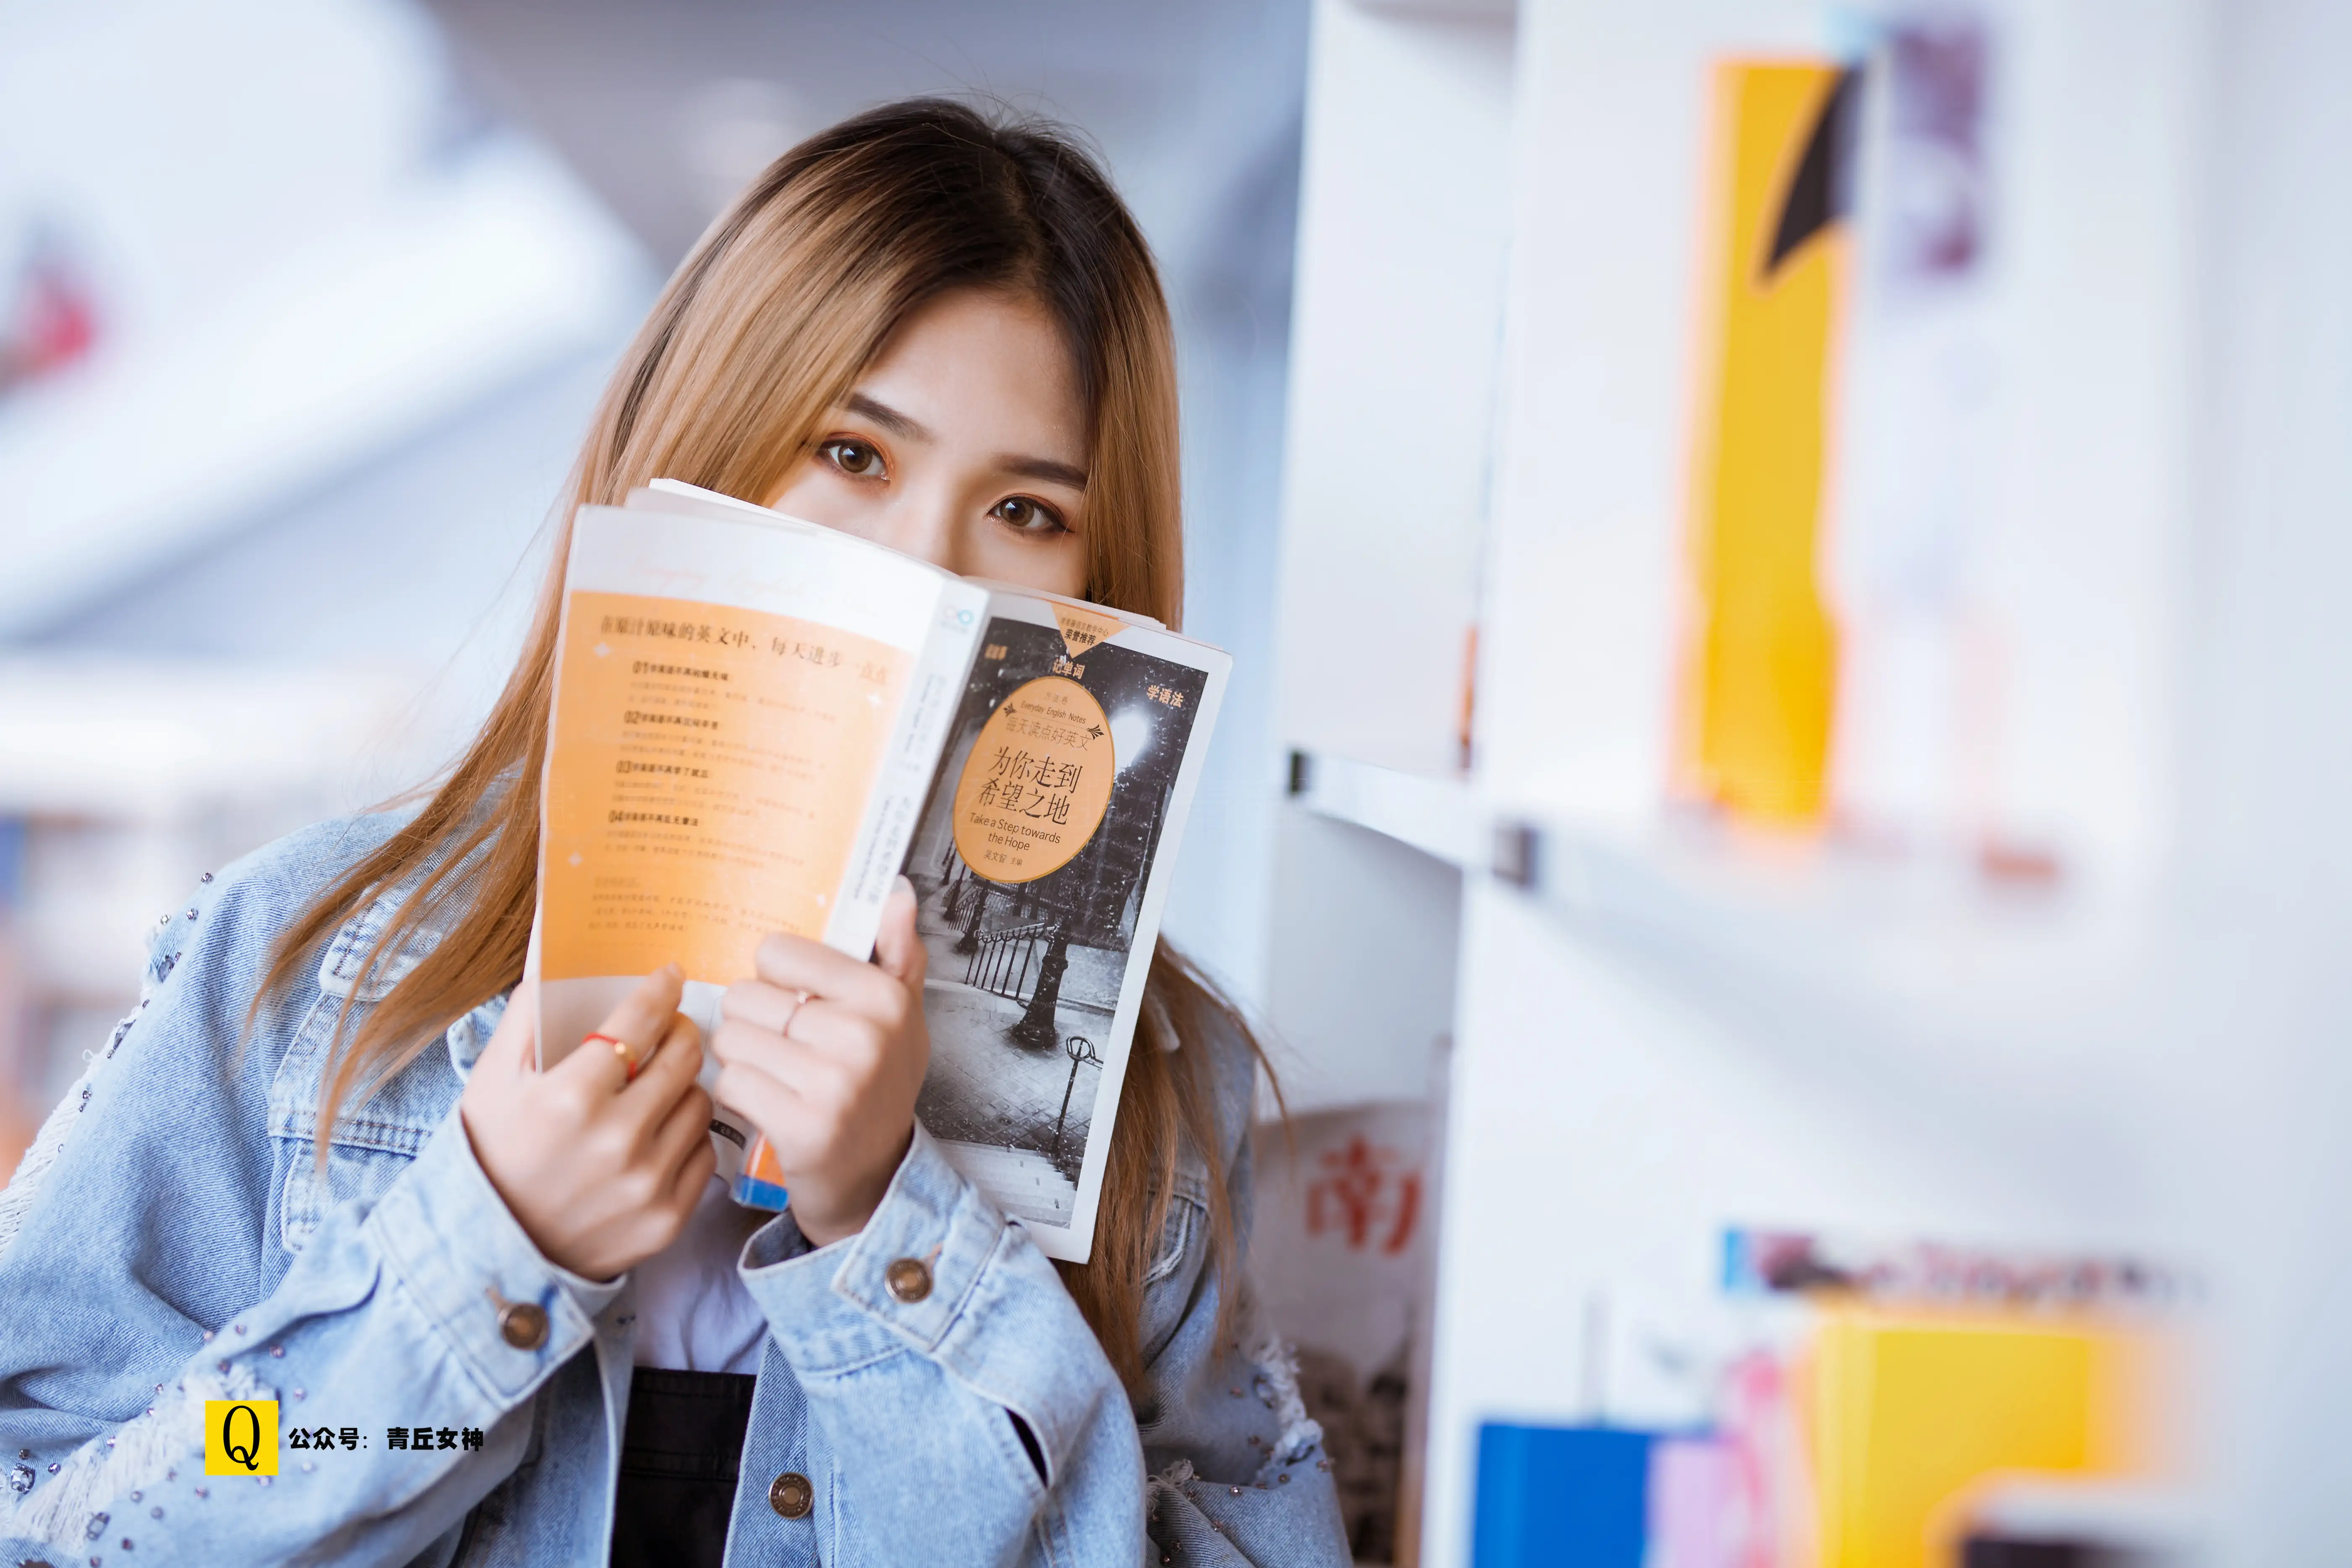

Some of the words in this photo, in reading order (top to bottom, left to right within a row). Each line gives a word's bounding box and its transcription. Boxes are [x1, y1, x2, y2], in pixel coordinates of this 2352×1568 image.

[1064, 628, 1096, 646] 荣誉推荐
[1052, 658, 1086, 680] 记单词
[1044, 691, 1069, 705] 方法卷
[1146, 684, 1184, 708] 学语法
[1021, 700, 1045, 714] Everyday
[1047, 707, 1066, 718] English
[1068, 713, 1086, 724] Notes
[1005, 716, 1092, 751] 每天读点好英文
[988, 746, 1083, 794] 为你走到
[978, 777, 1070, 825] 希望之地
[970, 812, 989, 826] Take
[990, 819, 996, 827] a
[997, 819, 1019, 834] Step
[1021, 825, 1061, 844] towards
[988, 832, 1003, 844] the
[1005, 836, 1030, 851] Hope
